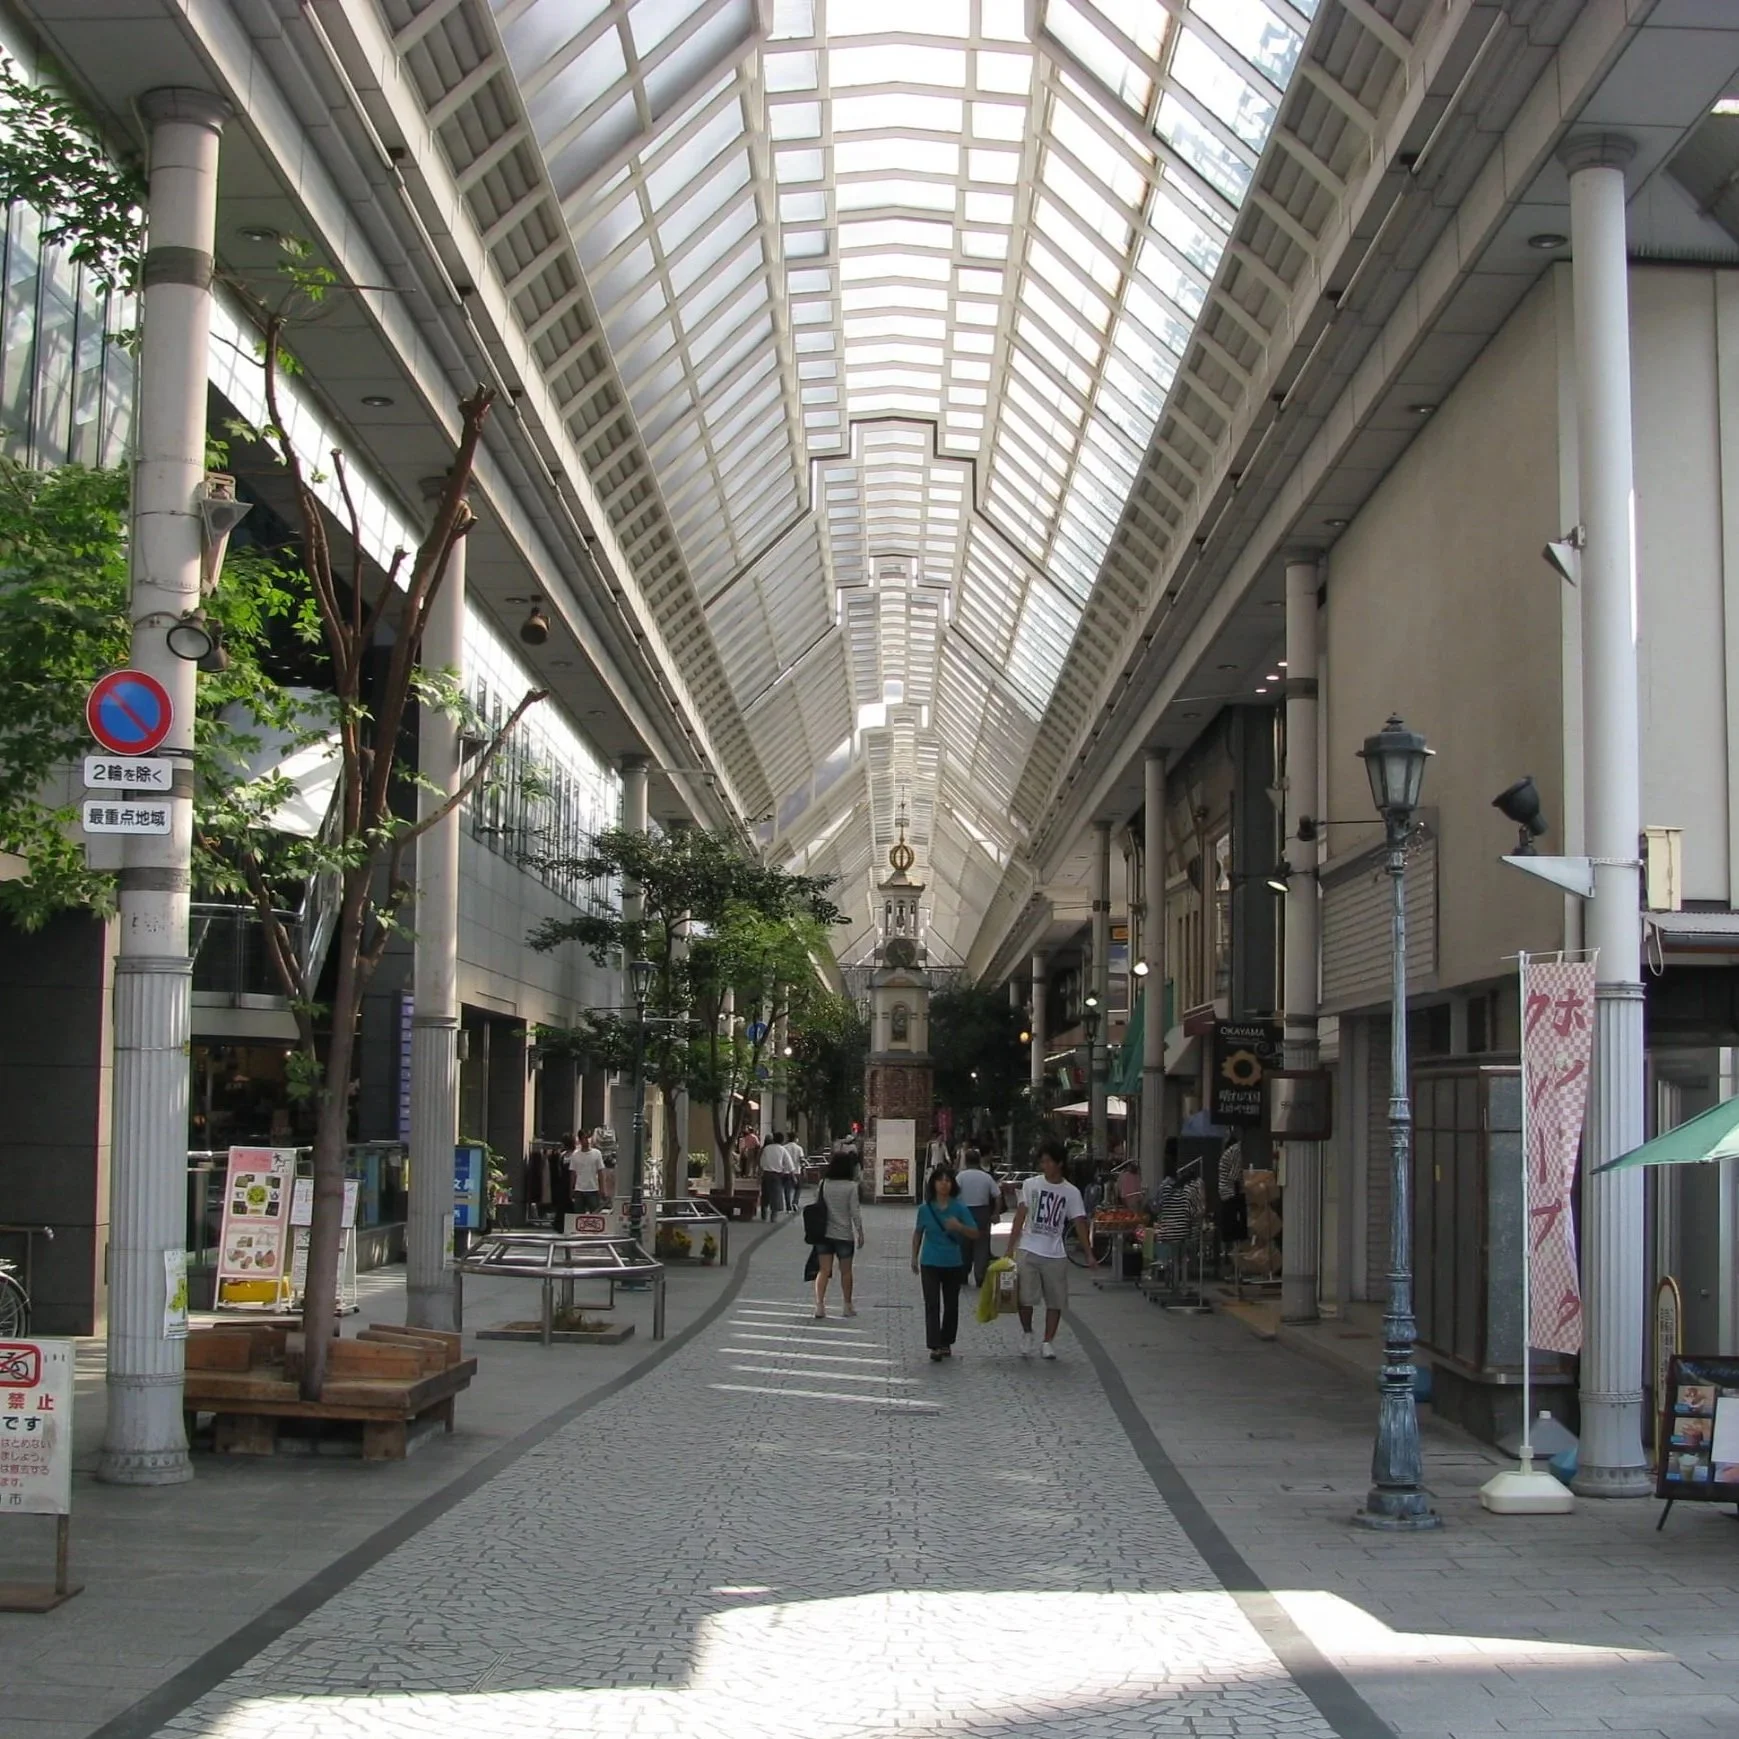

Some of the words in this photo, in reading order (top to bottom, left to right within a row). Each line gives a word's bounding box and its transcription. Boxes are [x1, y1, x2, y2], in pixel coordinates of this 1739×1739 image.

[93, 764, 163, 784] 2輪を除く
[88, 808, 166, 827] 最重点地域
[1220, 1026, 1265, 1037] OKAYAMA
[8, 1392, 55, 1411] 禁止
[3, 1416, 41, 1431] です
